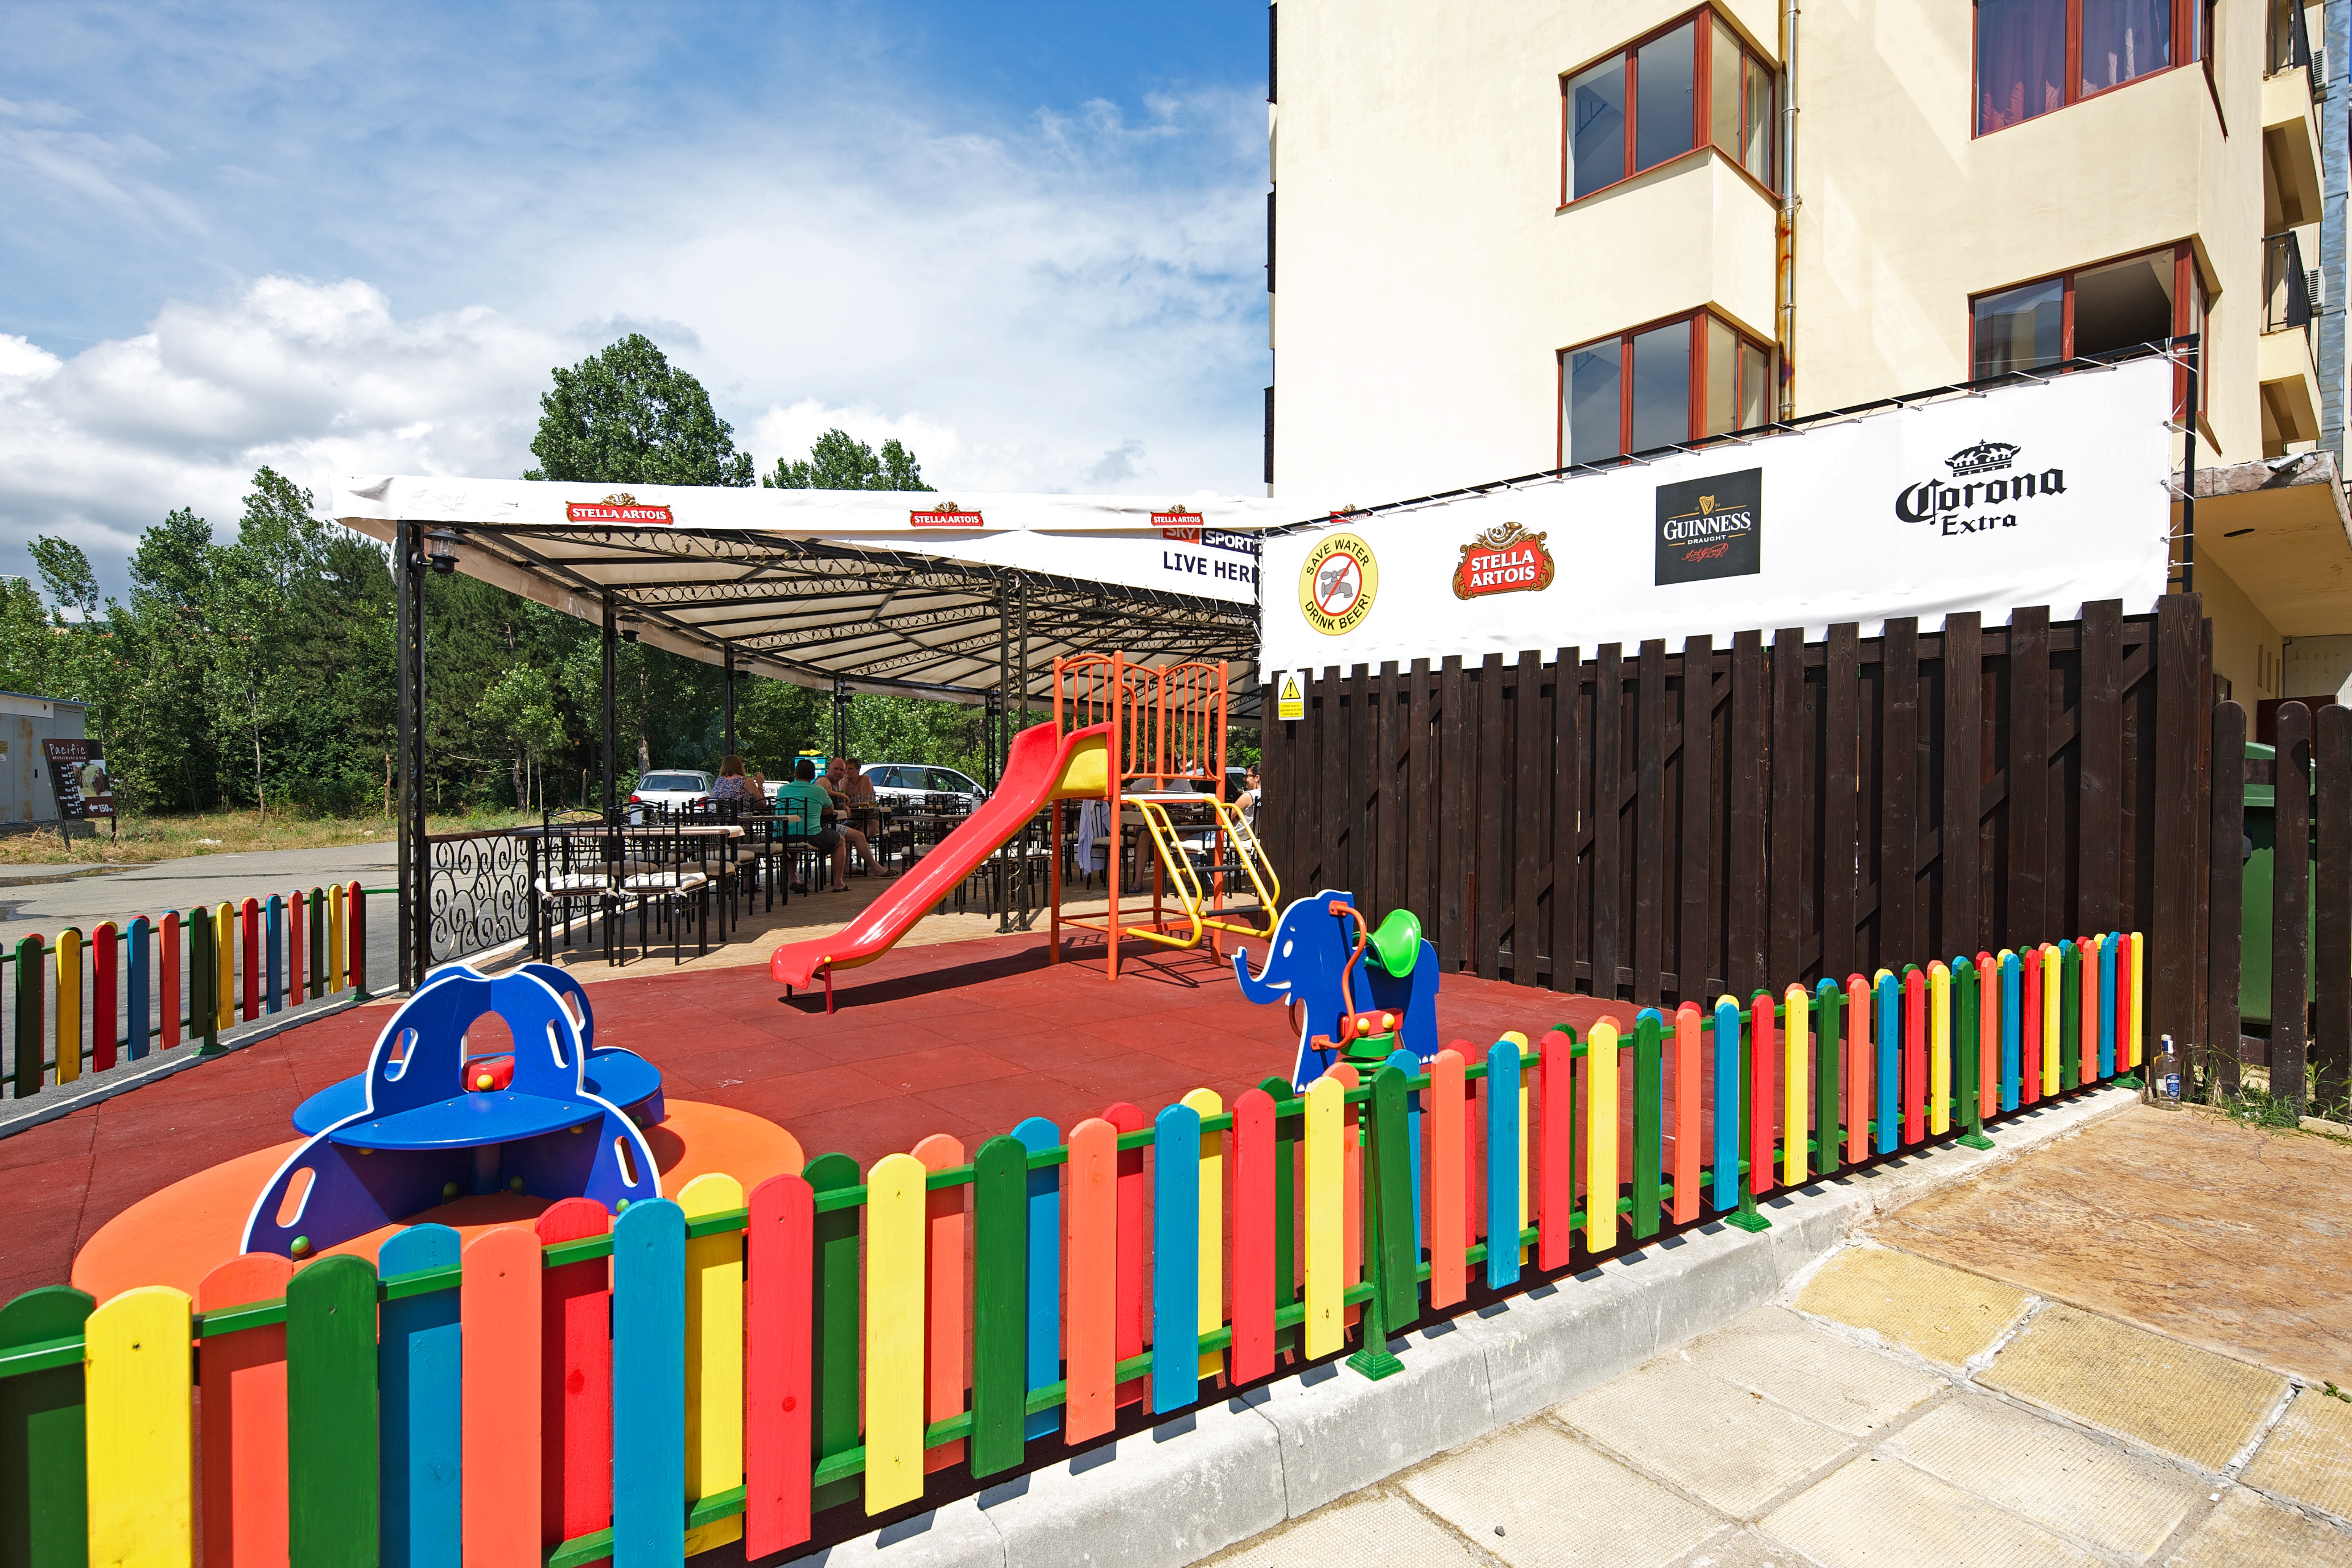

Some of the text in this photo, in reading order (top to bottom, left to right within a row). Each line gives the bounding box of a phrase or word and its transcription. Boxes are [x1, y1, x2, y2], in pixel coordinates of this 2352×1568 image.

[1895, 468, 2068, 525] Corona
[572, 508, 667, 520] STELLA ARTOIS
[1941, 513, 2018, 537] Extra
[1166, 528, 1195, 539] SKY
[1664, 511, 1751, 540] GUINNESS
[1485, 537, 1519, 550] ANNO 1366
[1687, 534, 1727, 545] DRAUGHT
[1163, 551, 1255, 584] LIVE HER
[1306, 539, 1369, 575] SAVE WATER
[1471, 550, 1535, 572] STELLA
[1470, 566, 1536, 588] ARTOIS
[1305, 593, 1371, 630] DRINK BEER!
[49, 743, 86, 756] Pacific
